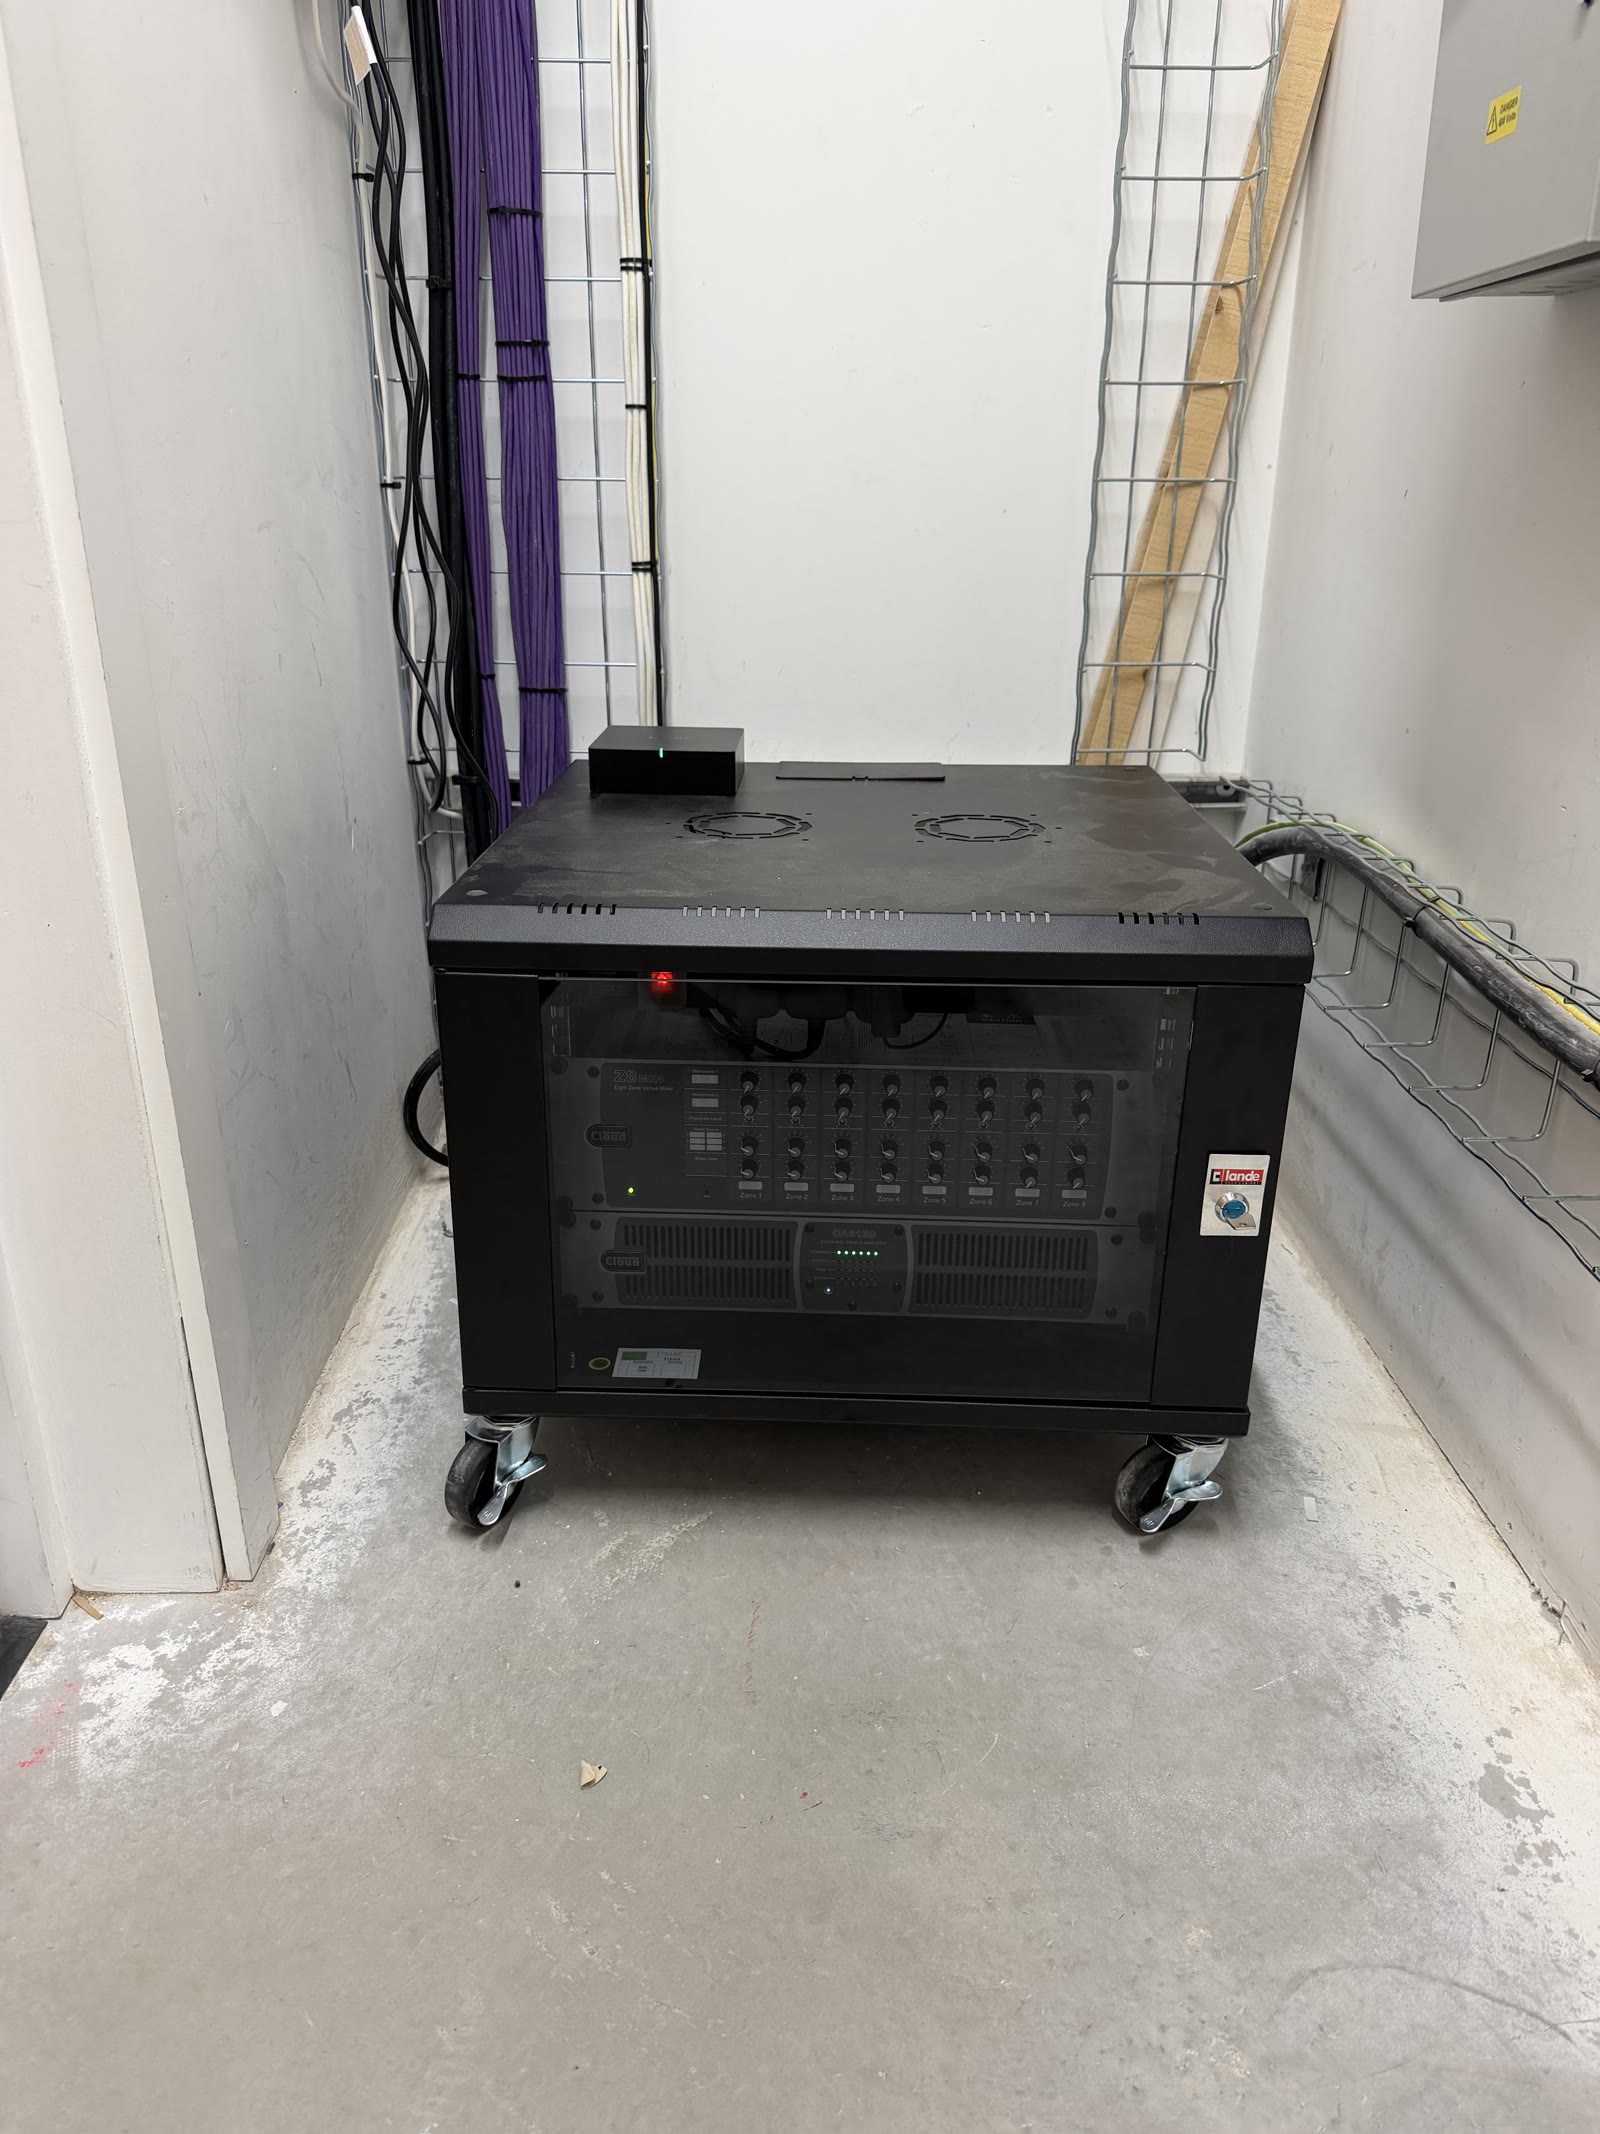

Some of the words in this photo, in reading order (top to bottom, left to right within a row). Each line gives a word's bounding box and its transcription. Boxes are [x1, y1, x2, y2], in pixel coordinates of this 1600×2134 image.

[1499, 96, 1518, 114] DANGER
[613, 1069, 638, 1083] Z8
[590, 1130, 627, 1142] Cloud
[1225, 1169, 1260, 1182] lande
[605, 1256, 640, 1267] Cloud
